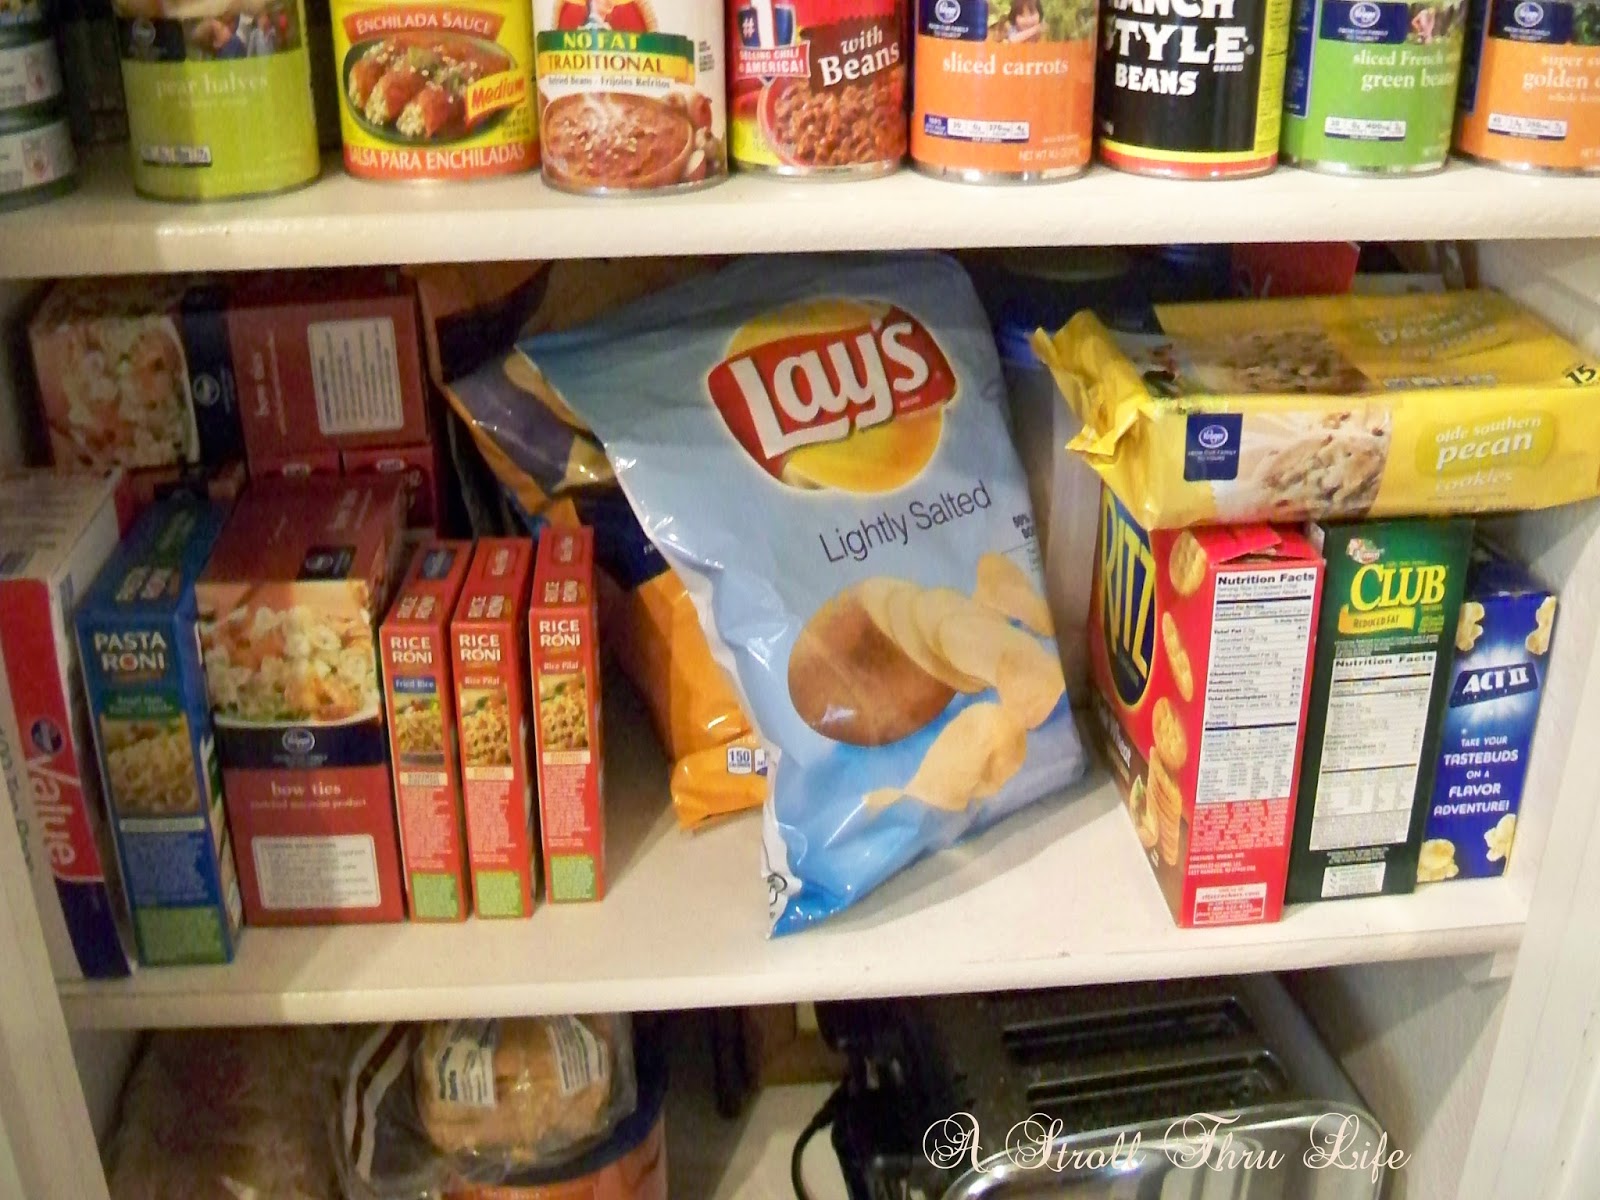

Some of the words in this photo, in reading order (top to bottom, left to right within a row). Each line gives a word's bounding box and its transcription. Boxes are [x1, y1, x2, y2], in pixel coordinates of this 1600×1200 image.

[357, 13, 438, 35] ENCHILADA
[443, 11, 491, 35] SAUCE
[563, 32, 592, 49] NO
[598, 33, 639, 50] FAT
[841, 24, 883, 54] with
[549, 54, 664, 73] TRADITIONAL
[818, 42, 900, 87] Beans
[943, 51, 996, 75] sliced
[1003, 57, 1069, 75] carrots
[1354, 49, 1396, 66] sliced
[1400, 50, 1443, 66] French
[1115, 63, 1199, 96] BEANS
[1361, 73, 1415, 92] green
[1522, 68, 1588, 91] golden
[472, 77, 525, 108] Medium
[381, 150, 422, 170] PARA
[426, 143, 526, 170] ENCHILADAS
[1565, 364, 1597, 387] 15
[728, 317, 929, 460] Lay's
[1436, 425, 1468, 443] olde
[1474, 416, 1541, 436] southern
[1436, 432, 1532, 471] pecan
[819, 512, 909, 563] Lightly
[909, 480, 992, 530] Salted
[1218, 574, 1276, 585] Nutrition
[1280, 573, 1315, 582] Facts
[1350, 563, 1446, 611] CLUB
[540, 620, 580, 632] RICE
[1354, 618, 1385, 628] REDUCED
[1387, 615, 1400, 624] FAT
[95, 632, 167, 651] PASTA
[390, 636, 431, 650] RICE
[459, 633, 500, 647] RICE
[541, 632, 580, 647] RONI
[101, 652, 165, 671] RONI
[392, 650, 433, 664] RONI
[461, 648, 501, 662] RONI
[1335, 657, 1392, 667] Nutrition
[1399, 655, 1433, 663] Facts
[544, 661, 560, 671] Rice
[562, 660, 579, 671] Pilaf
[395, 680, 415, 689] Fried
[417, 680, 434, 688] Rice
[464, 676, 481, 685] Rice
[483, 676, 500, 685] Pilaf
[1463, 670, 1505, 694] ACT
[1509, 667, 1530, 686] II
[1461, 738, 1480, 747] TAKE
[1483, 735, 1508, 746] YOUR
[730, 750, 750, 762] 150
[1444, 749, 1518, 766] TASTEBUDS
[1466, 770, 1481, 779] ON
[1484, 770, 1490, 779] A
[271, 781, 305, 796] bow
[311, 781, 341, 796] ties
[1449, 783, 1501, 798] FLAVOR
[28, 754, 82, 866] Value
[1433, 800, 1510, 816] ADVENTURE!
